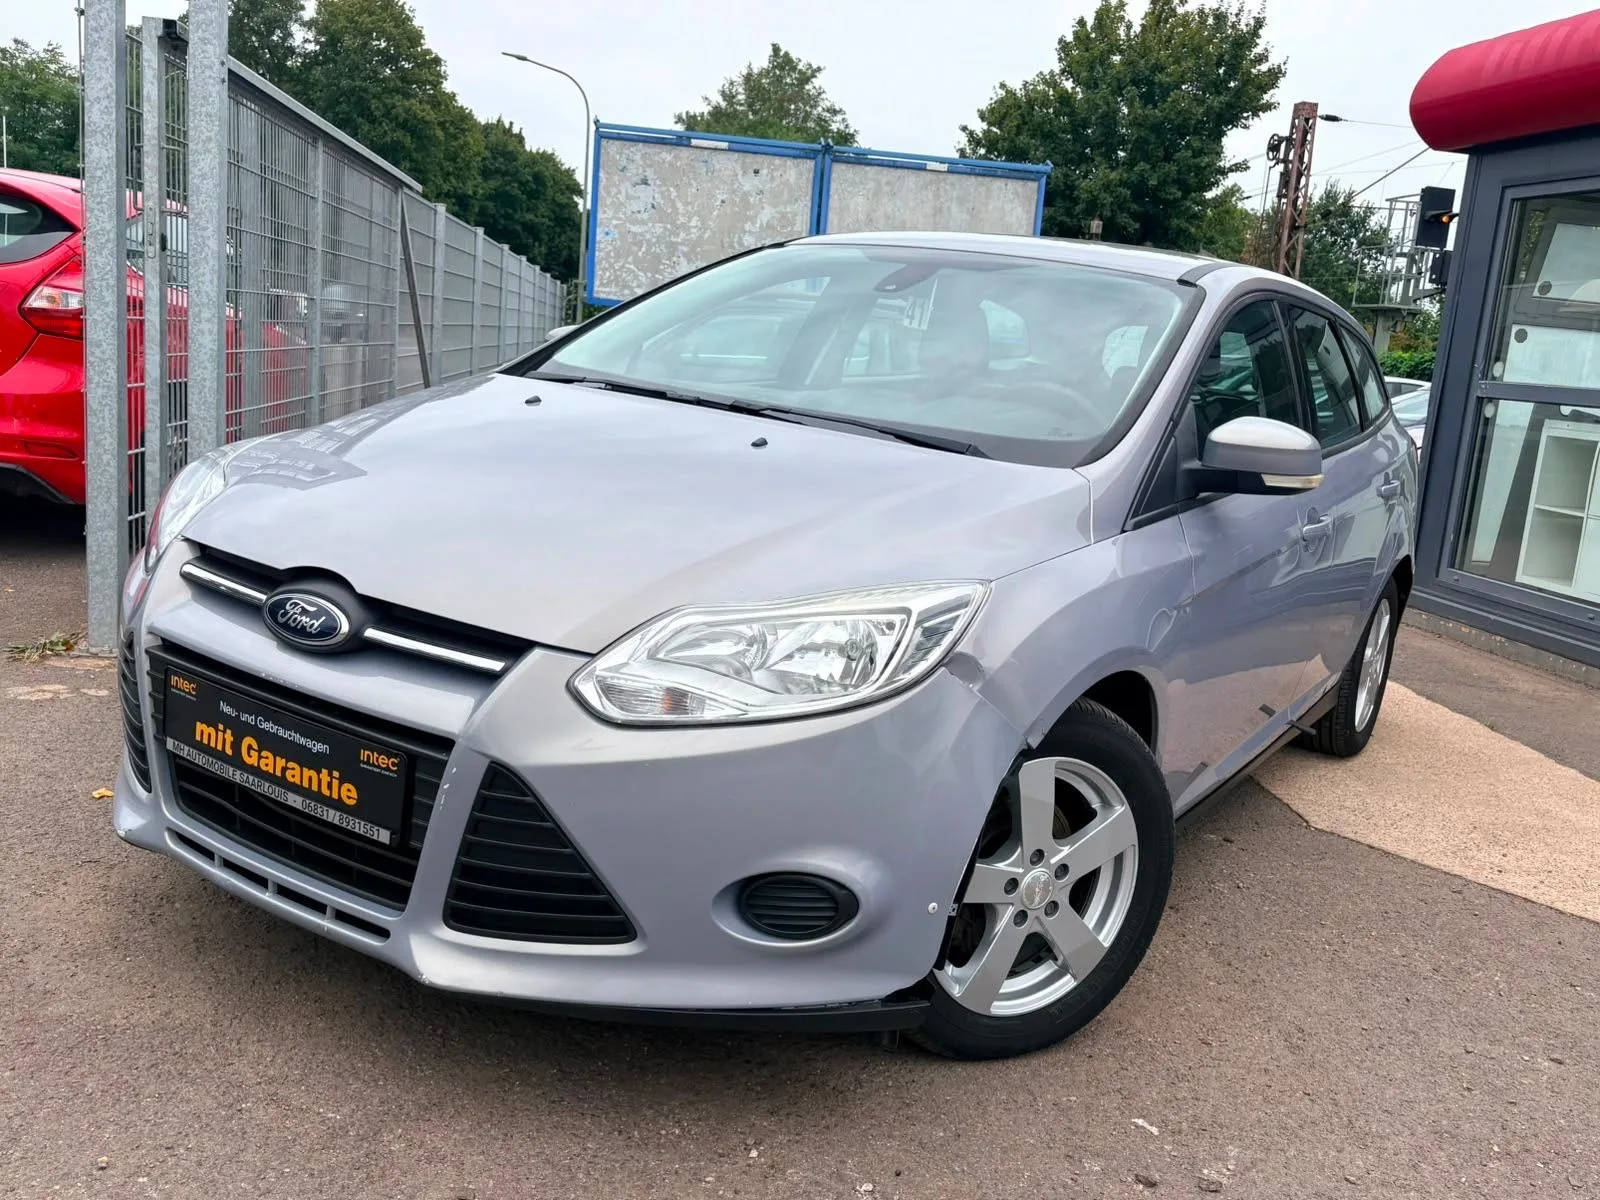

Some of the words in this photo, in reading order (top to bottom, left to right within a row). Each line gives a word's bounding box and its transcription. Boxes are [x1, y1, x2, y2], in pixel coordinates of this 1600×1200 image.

[278, 600, 326, 633] Ford
[220, 700, 239, 718] Neu-
[240, 711, 255, 725] und
[257, 716, 330, 754] Gebrauchtwagen
[172, 741, 185, 755] MH
[186, 745, 237, 780] AUTOMOBILE
[238, 772, 289, 802] SAARLOUIS
[301, 798, 330, 819] 06831
[338, 814, 381, 840] 8931551
[195, 721, 234, 756] mit
[241, 735, 358, 806] Garantie
